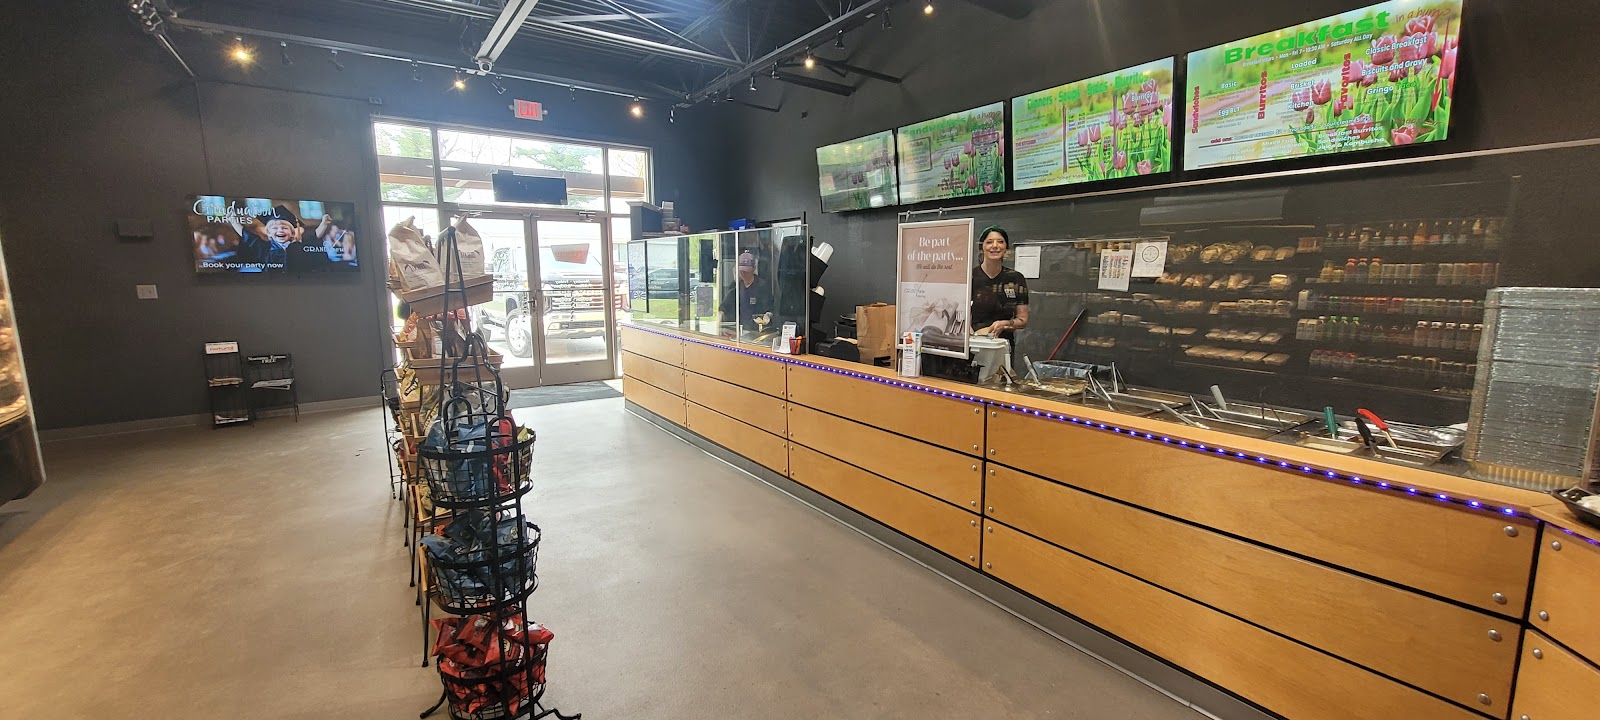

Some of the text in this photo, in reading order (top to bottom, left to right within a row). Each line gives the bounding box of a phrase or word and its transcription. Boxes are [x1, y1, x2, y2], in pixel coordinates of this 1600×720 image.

[1407, 10, 1414, 18] a
[1224, 11, 1391, 65] Breakfast
[1331, 38, 1353, 47] Saturday
[1365, 36, 1427, 55] Classic Breakfast
[1291, 58, 1317, 69] Loaded
[1361, 58, 1428, 76] Biscuits and Gravy
[1221, 81, 1237, 89] Basic
[1341, 53, 1351, 109] Favorites
[1258, 71, 1267, 119] Burritos
[1367, 85, 1394, 95] Gringo
[518, 100, 539, 119] EXIT
[1191, 86, 1200, 134] Sandwiches
[1287, 101, 1314, 110] Kitchen
[1218, 108, 1229, 117] Egg
[1317, 135, 1360, 144] Sandwiches
[1344, 137, 1385, 147] Kombucha
[193, 198, 280, 219] Graduation
[207, 216, 253, 225] PARTIES
[919, 236, 951, 249] Be part
[907, 249, 916, 261] of
[917, 250, 931, 261] the
[225, 262, 244, 270] your
[245, 262, 266, 270] party
